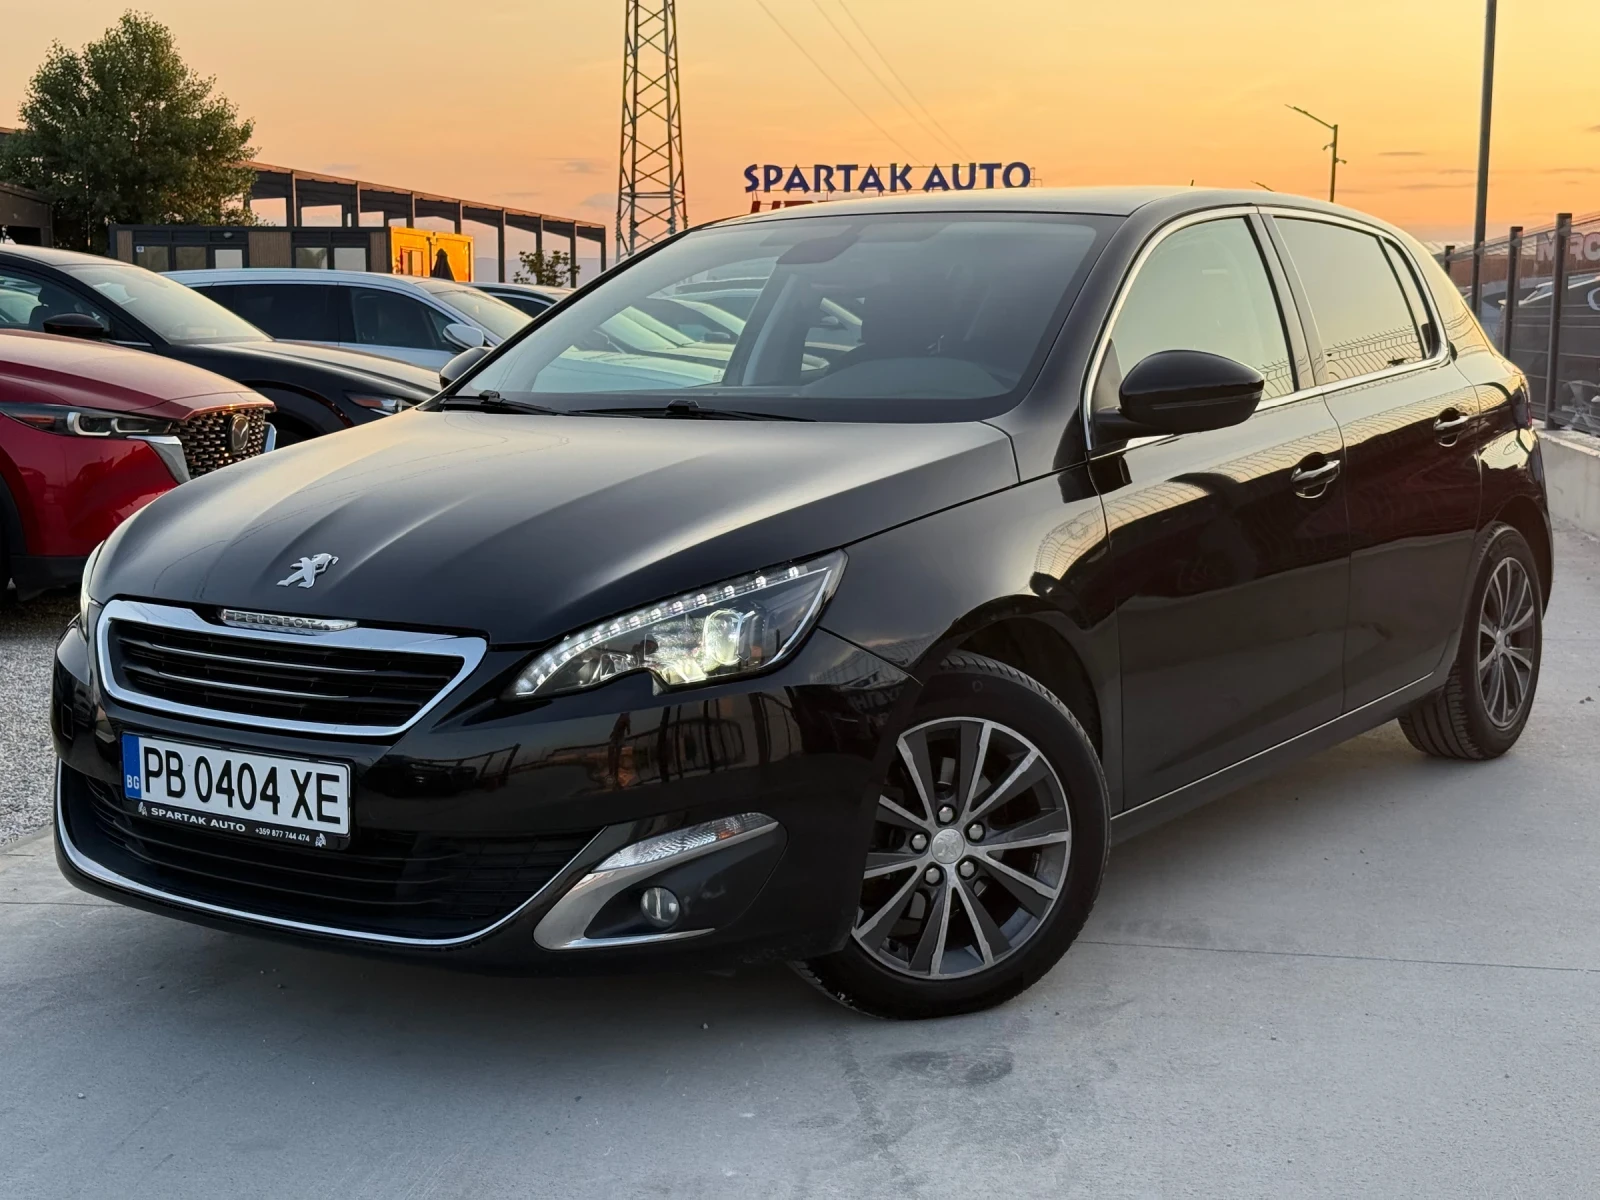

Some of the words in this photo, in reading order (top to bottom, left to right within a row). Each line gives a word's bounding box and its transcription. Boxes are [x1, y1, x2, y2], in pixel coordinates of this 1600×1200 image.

[744, 163, 912, 194] SPARTAK
[923, 162, 1031, 192] AUTO
[234, 612, 315, 629] PEUGEOT
[126, 775, 140, 789] BG
[144, 746, 186, 798] PB
[194, 756, 280, 816] 0404
[290, 769, 341, 825] XE
[151, 808, 207, 826] SPARTAK
[210, 819, 246, 832] AUTO
[255, 827, 270, 836] +359
[271, 829, 283, 838] 877
[284, 831, 297, 840] 744
[297, 833, 310, 843] 474
